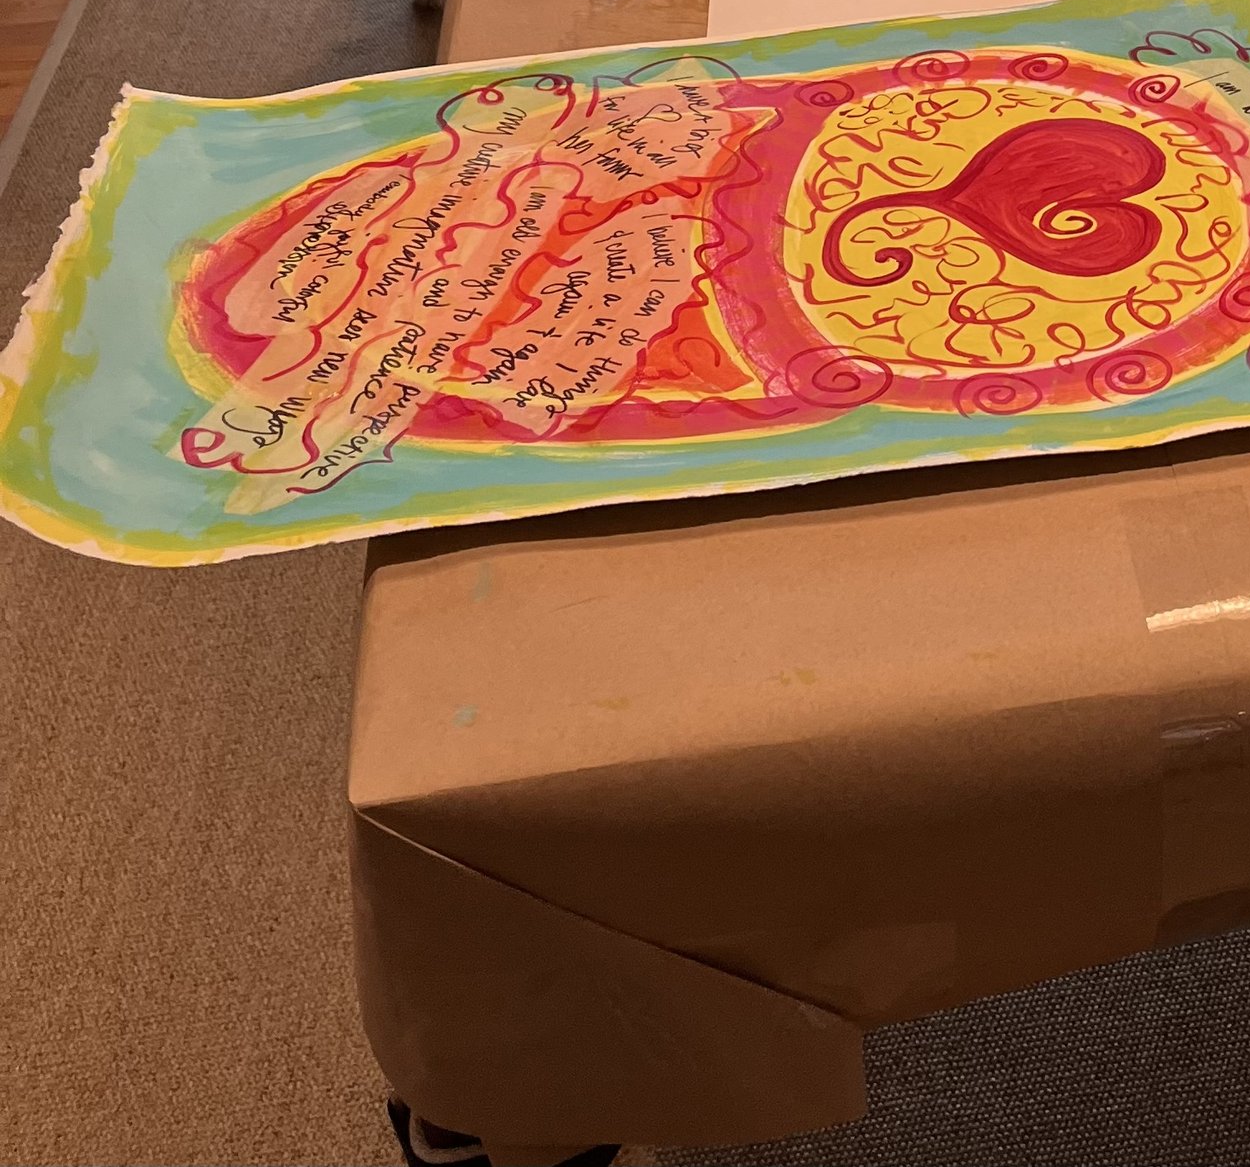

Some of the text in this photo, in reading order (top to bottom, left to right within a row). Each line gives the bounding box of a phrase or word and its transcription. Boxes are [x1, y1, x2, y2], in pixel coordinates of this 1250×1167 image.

[674, 84, 710, 116] have
[1214, 81, 1242, 96] am
[599, 96, 626, 112] for
[555, 126, 595, 155] her
[604, 114, 638, 141] life
[670, 128, 722, 159] big
[450, 142, 504, 188] creative
[647, 151, 678, 169] all
[351, 181, 401, 220] embody
[523, 192, 547, 212] am
[511, 217, 541, 244] old
[308, 228, 370, 269] joyful
[646, 225, 685, 268] believe
[460, 248, 522, 301] enough
[605, 242, 636, 283] create
[271, 274, 329, 323] colorful
[422, 278, 451, 307] and
[541, 271, 592, 319] again
[602, 293, 622, 307] a
[633, 289, 666, 317] can
[453, 307, 483, 323] to
[574, 317, 617, 347] life
[618, 328, 647, 347] do
[306, 351, 349, 384] new
[416, 332, 467, 374] have
[471, 343, 539, 385] again
[555, 362, 578, 373] I
[300, 382, 421, 479] perspective
